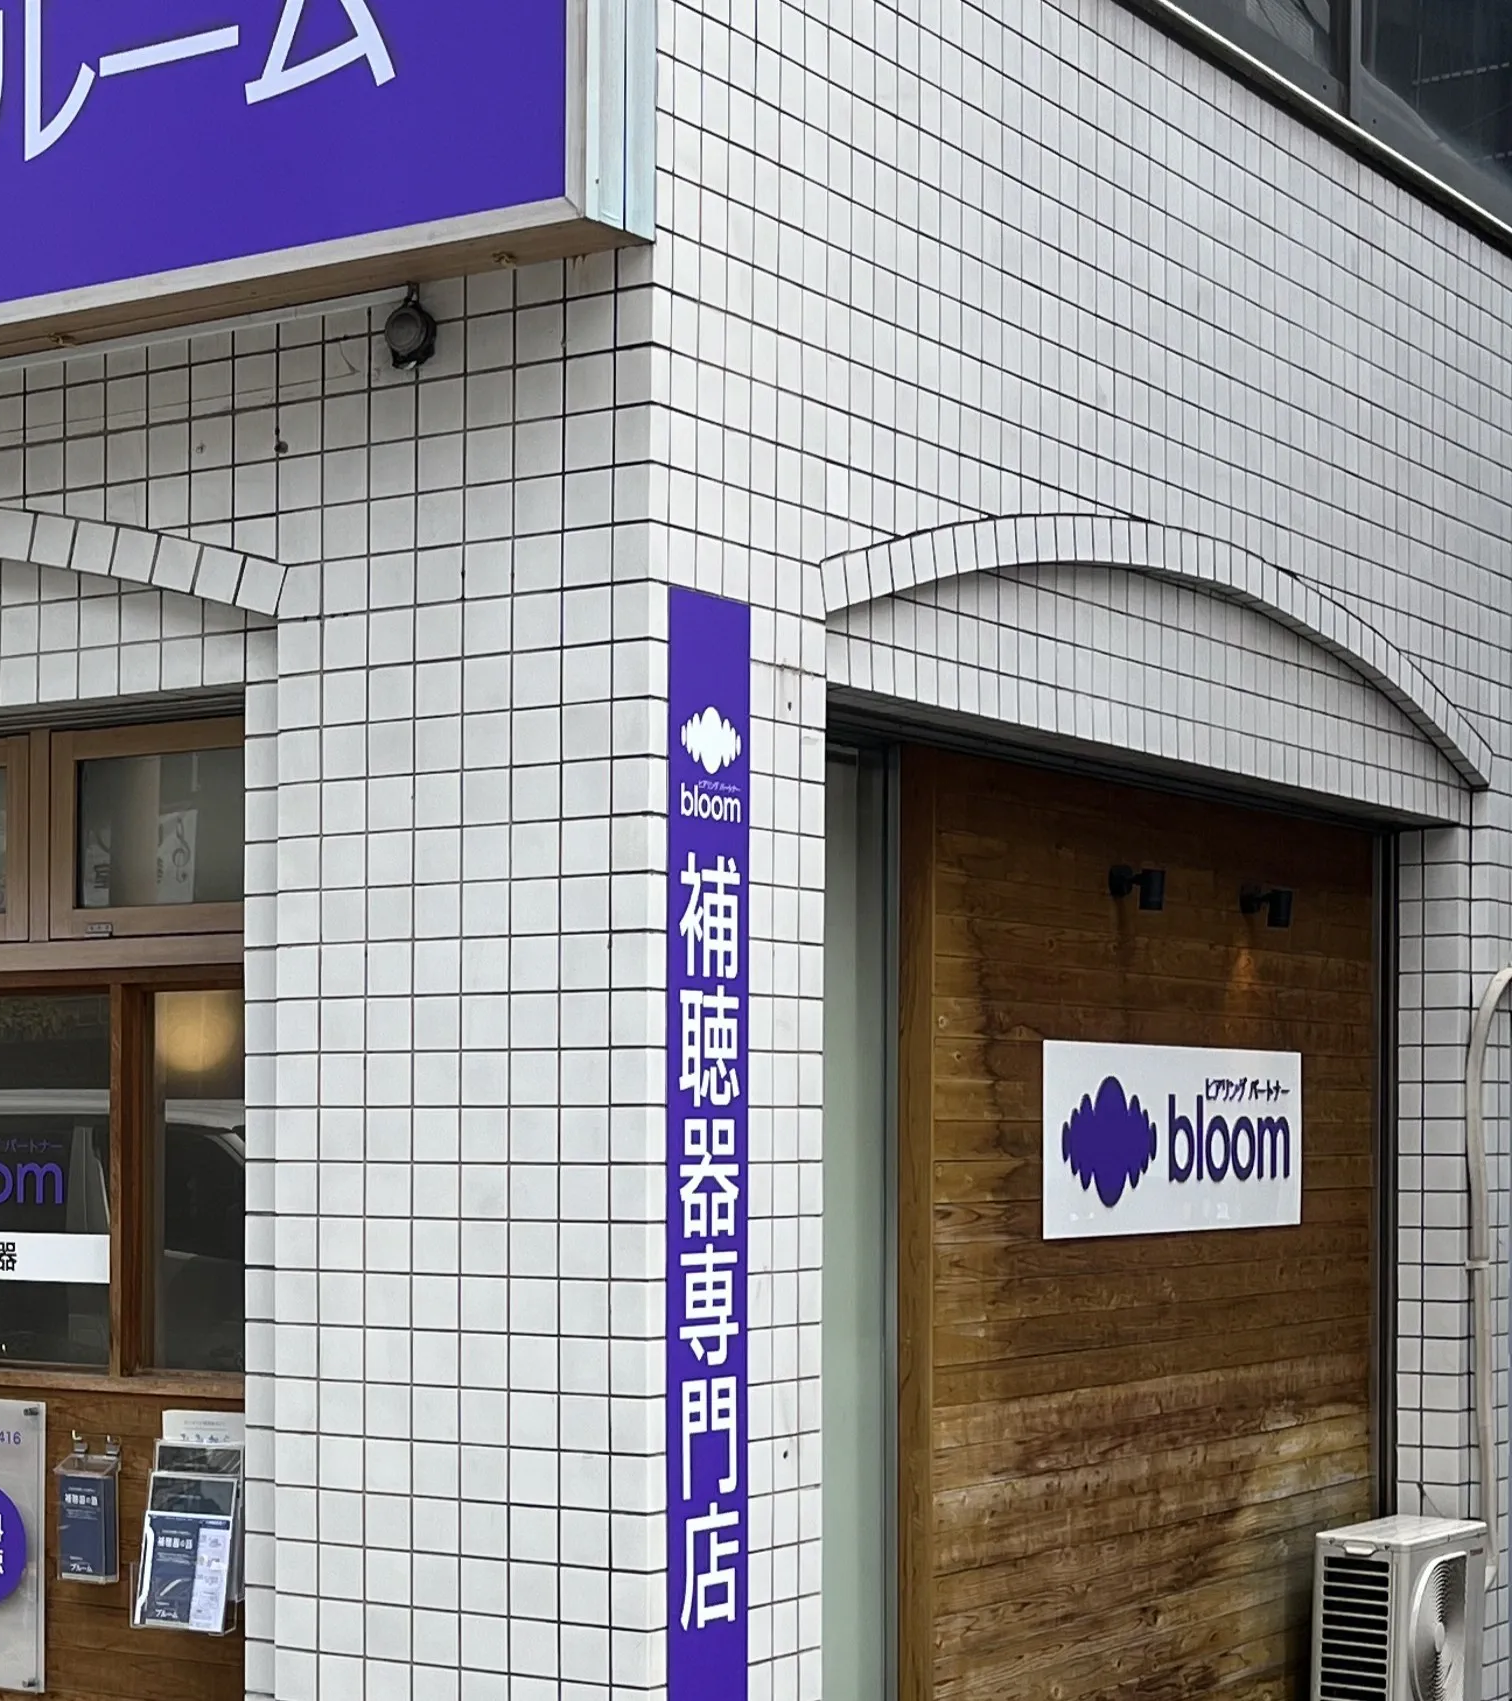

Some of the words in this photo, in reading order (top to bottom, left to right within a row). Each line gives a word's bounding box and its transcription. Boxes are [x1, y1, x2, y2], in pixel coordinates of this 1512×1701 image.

[680, 782, 741, 823] bloom
[1205, 1077, 1247, 1101] ヒアリング
[1248, 1079, 1290, 1102] パートナー
[4, 1139, 63, 1153] パートナー
[1168, 1094, 1290, 1183] bloom
[677, 851, 740, 1631] 補聴器専門店
